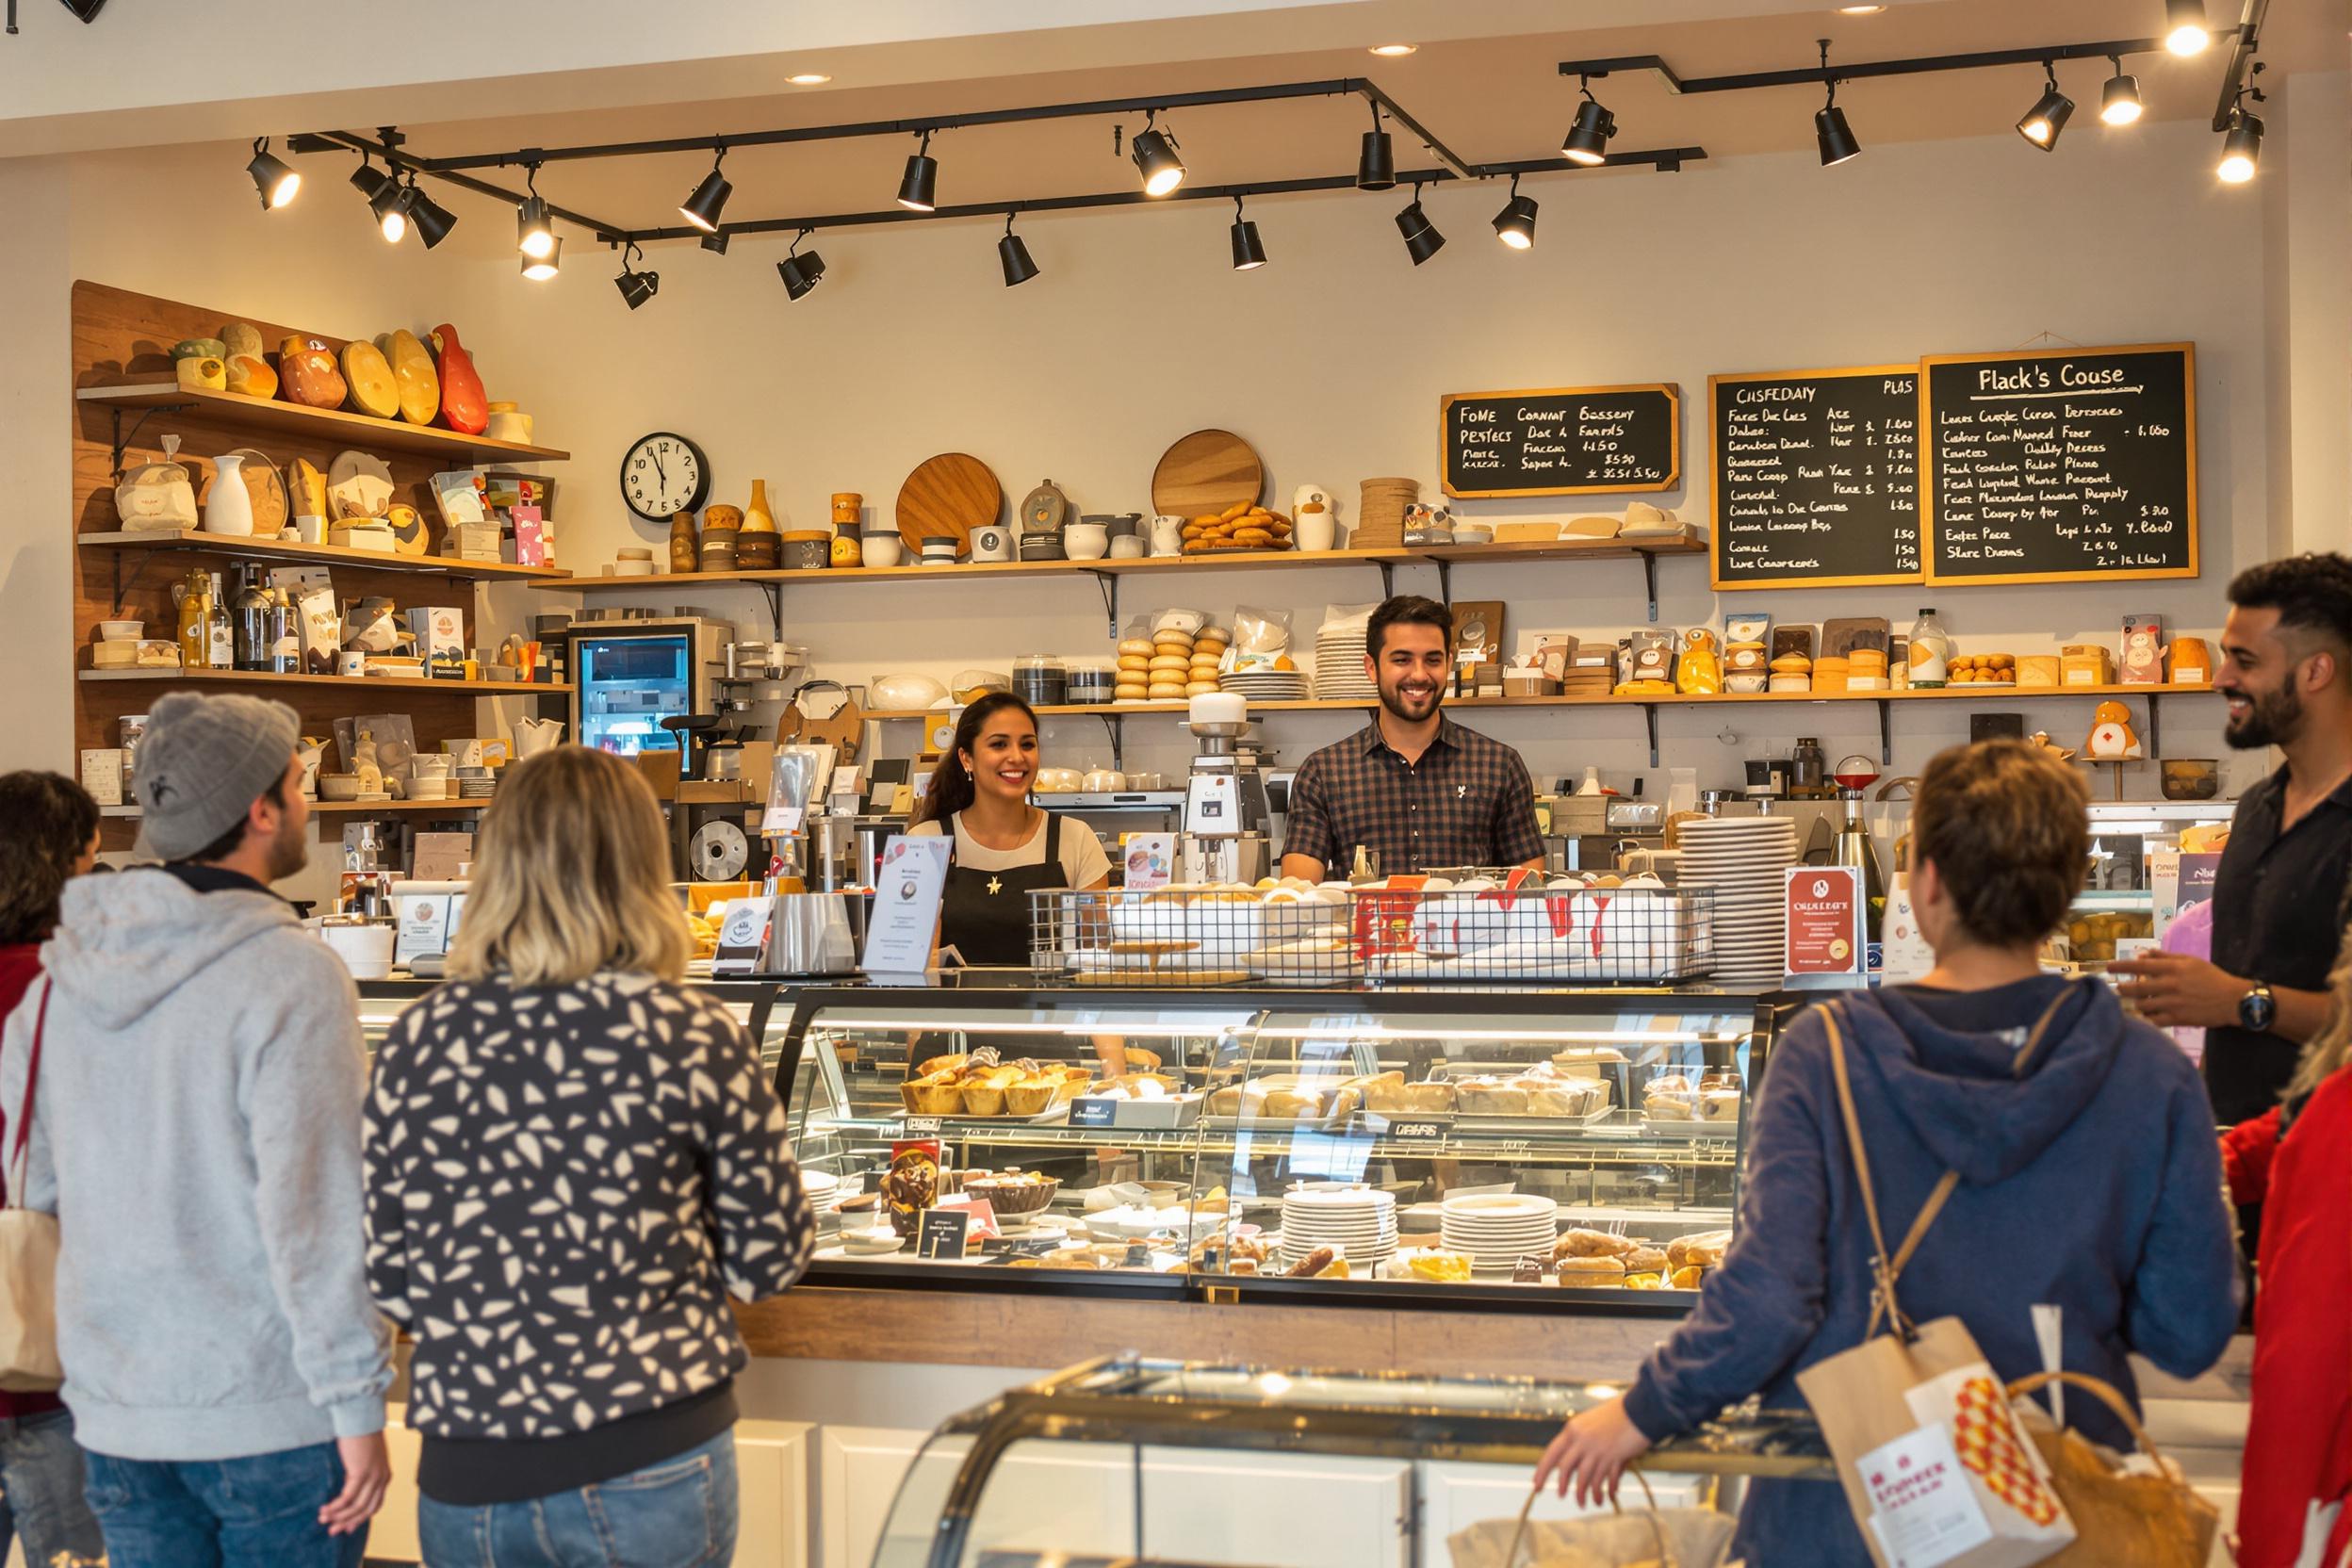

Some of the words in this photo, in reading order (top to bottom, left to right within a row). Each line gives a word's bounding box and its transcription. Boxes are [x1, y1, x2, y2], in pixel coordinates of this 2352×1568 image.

[1979, 366, 2050, 391] Flack's
[635, 460, 646, 469] 10
[684, 456, 692, 466] 2
[631, 475, 638, 484] 9
[689, 471, 695, 481] 3
[635, 490, 643, 498] 8
